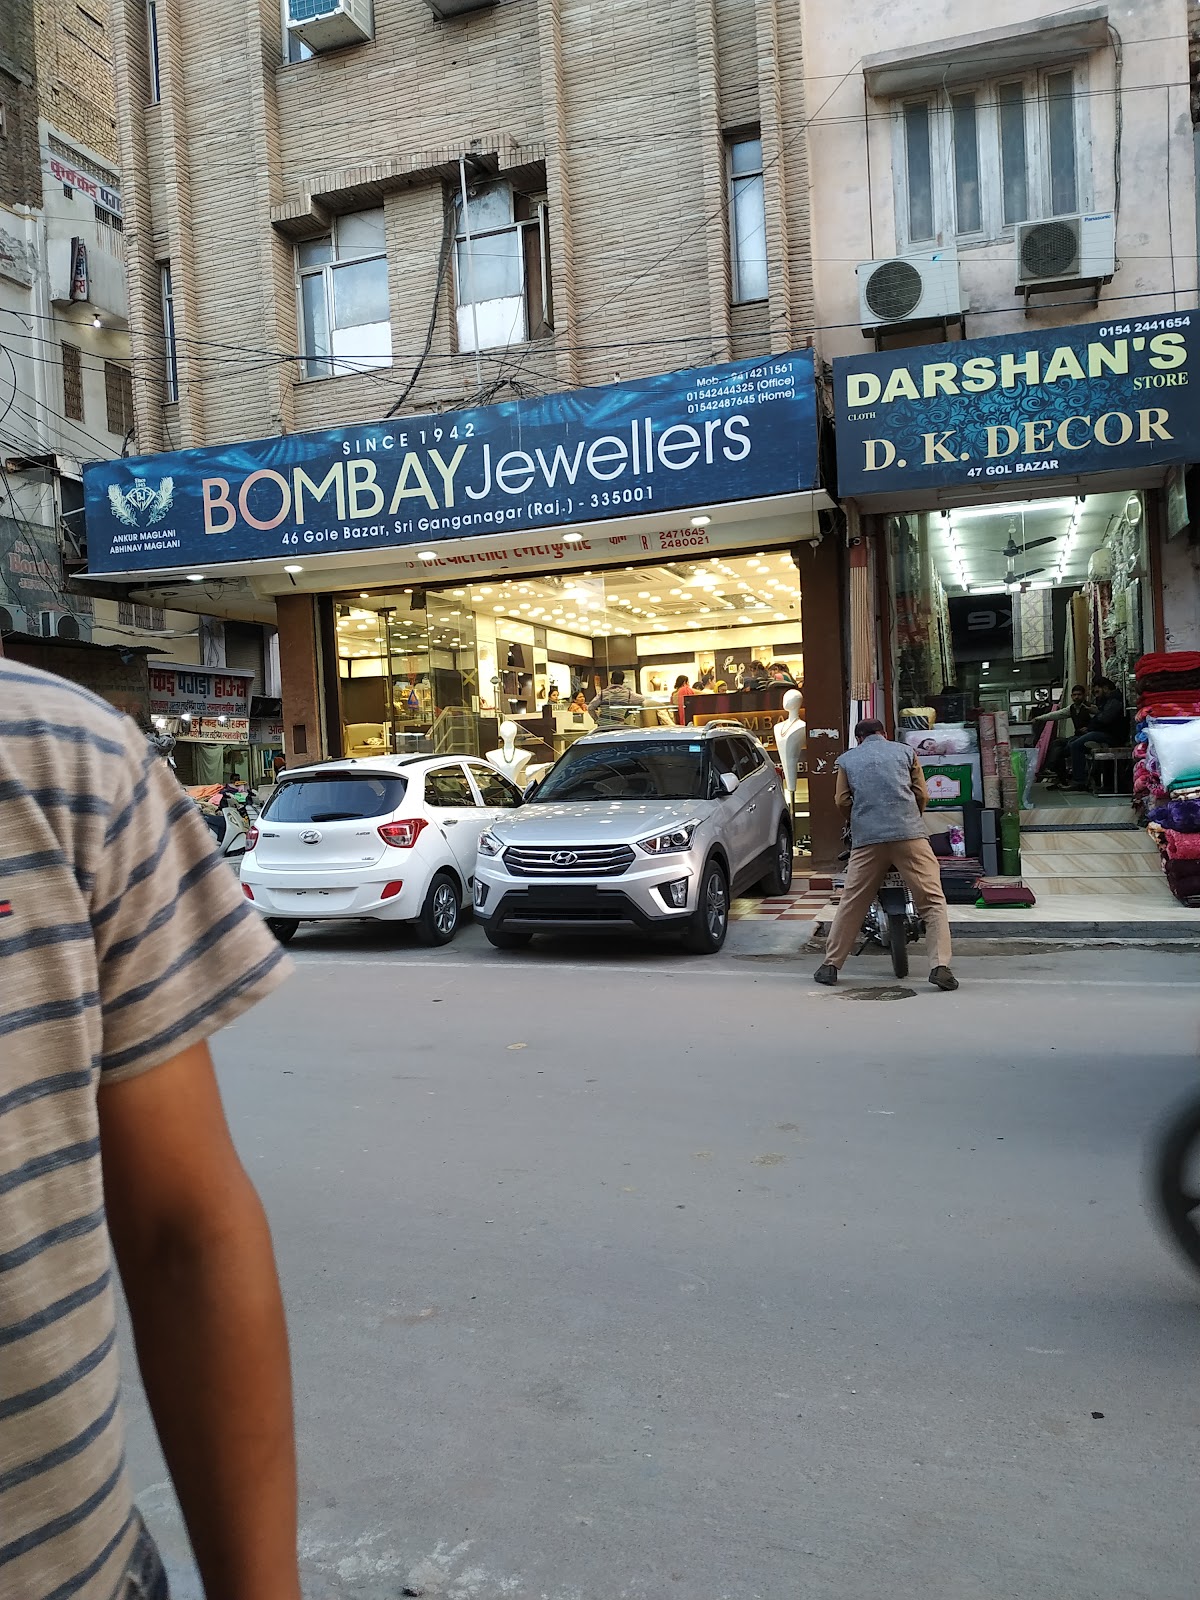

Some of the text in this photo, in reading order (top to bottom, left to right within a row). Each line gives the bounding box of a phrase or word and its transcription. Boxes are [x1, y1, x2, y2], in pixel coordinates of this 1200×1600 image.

[1084, 214, 1111, 222] Panasonic
[1099, 316, 1191, 337] 0154 2441654
[846, 332, 1188, 408] DARSHAN'S
[686, 375, 795, 402] 01542444325 (Office)
[696, 376, 722, 387] Mob.
[1133, 372, 1189, 391] STORE
[687, 388, 796, 414] 01542487645 (Home)
[847, 411, 876, 422] CLOTH
[342, 422, 475, 455] SINCE 1942
[862, 407, 1174, 472] D. K. DECOR
[202, 414, 752, 535] BOMBAY Jewellers
[967, 459, 1060, 478] 47 GOL BAZAR
[281, 531, 299, 546] 46
[303, 528, 339, 543] Gole
[343, 523, 390, 540] Bazar,
[394, 519, 413, 535] Sri
[417, 506, 523, 532] Ganganagar
[527, 498, 574, 520] (Raj.)
[590, 486, 654, 508] 335001
[112, 529, 176, 544] ANKUR MAGLANI
[659, 527, 706, 540] 2471645
[661, 536, 710, 550] 2480021
[109, 539, 181, 555] ABHINAV MAGLANI
